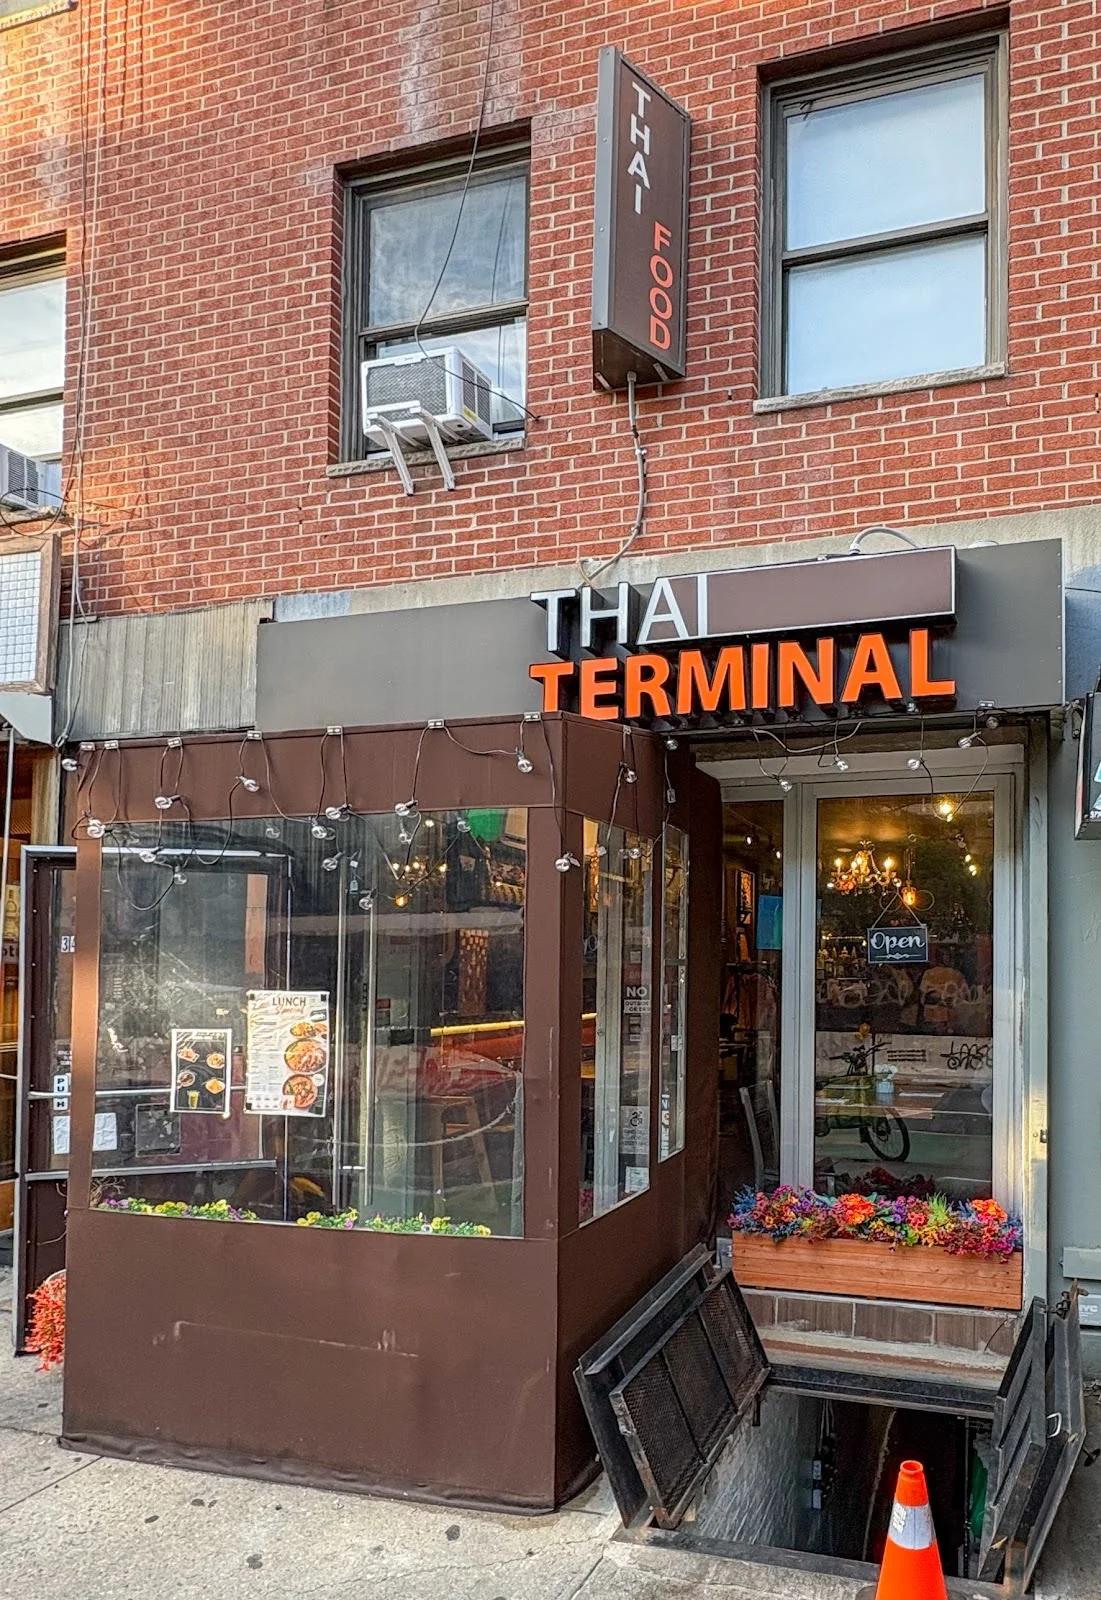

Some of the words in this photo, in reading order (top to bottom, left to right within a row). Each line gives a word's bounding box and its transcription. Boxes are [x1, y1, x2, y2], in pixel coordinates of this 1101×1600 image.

[627, 81, 651, 215] THAI
[650, 220, 673, 351] FOOD
[530, 574, 709, 652] THAI
[529, 628, 957, 720] TERMINAL
[870, 932, 925, 954] Open
[272, 996, 307, 1006] LUNCH
[626, 986, 648, 997] NO
[57, 1078, 65, 1108] PUH
